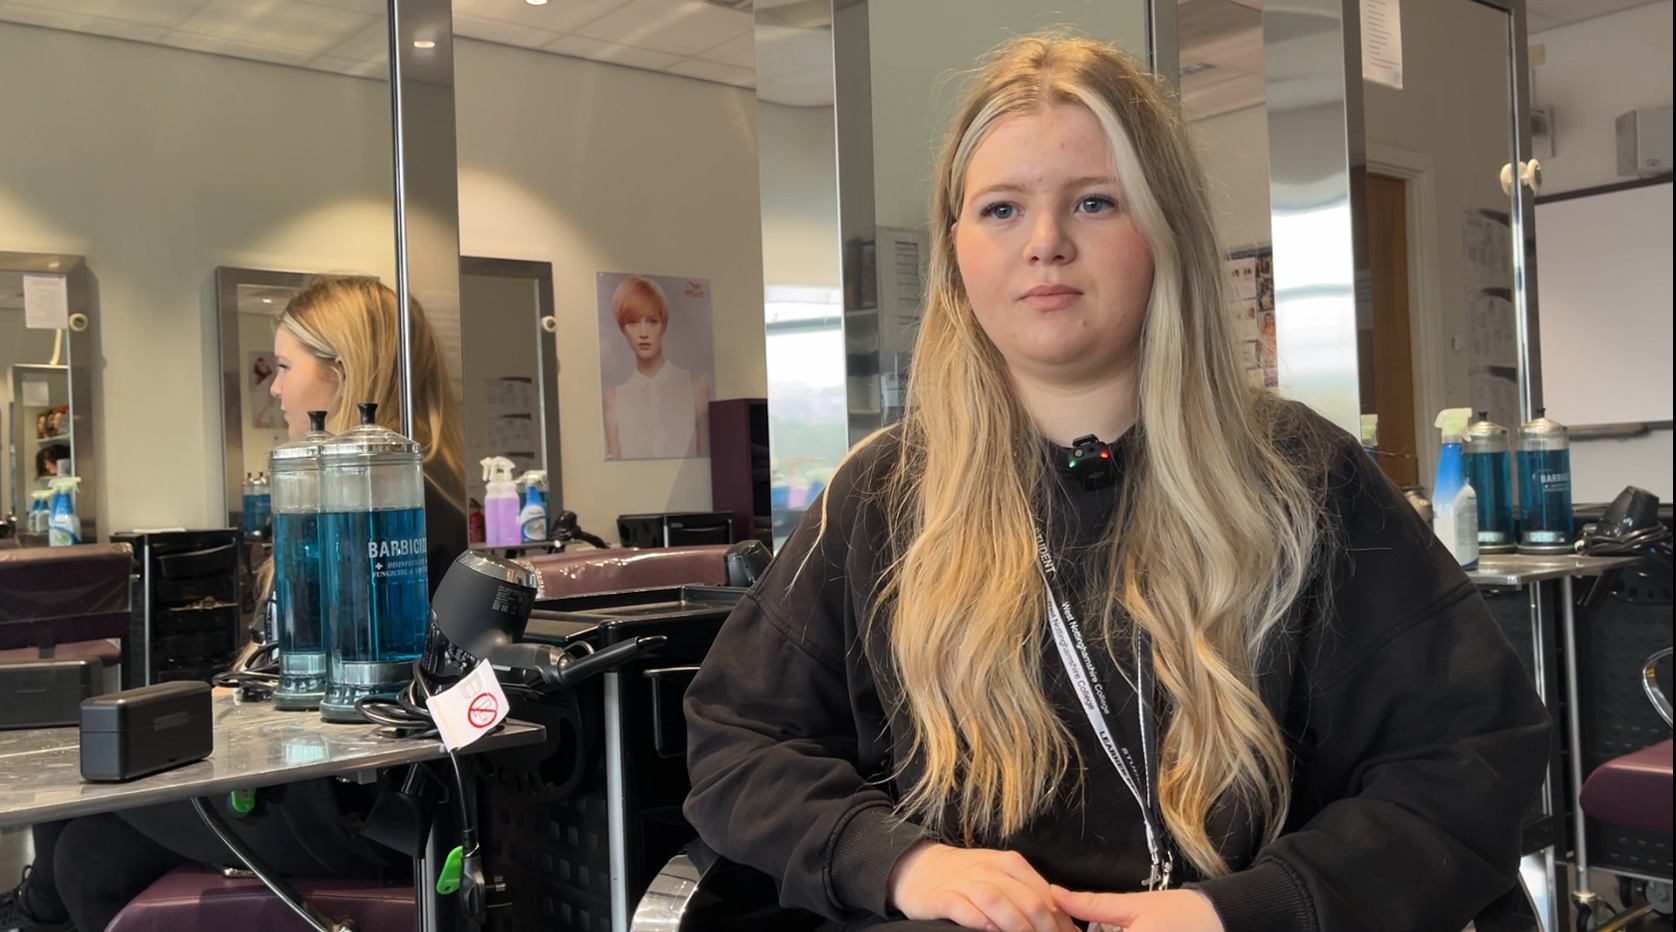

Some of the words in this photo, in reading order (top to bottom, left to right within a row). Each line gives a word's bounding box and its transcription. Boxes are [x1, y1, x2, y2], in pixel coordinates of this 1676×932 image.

[1062, 601, 1075, 622] West
[1069, 621, 1098, 683] Nottinghamshire
[1094, 683, 1110, 715] College
[1077, 680, 1094, 710] College
